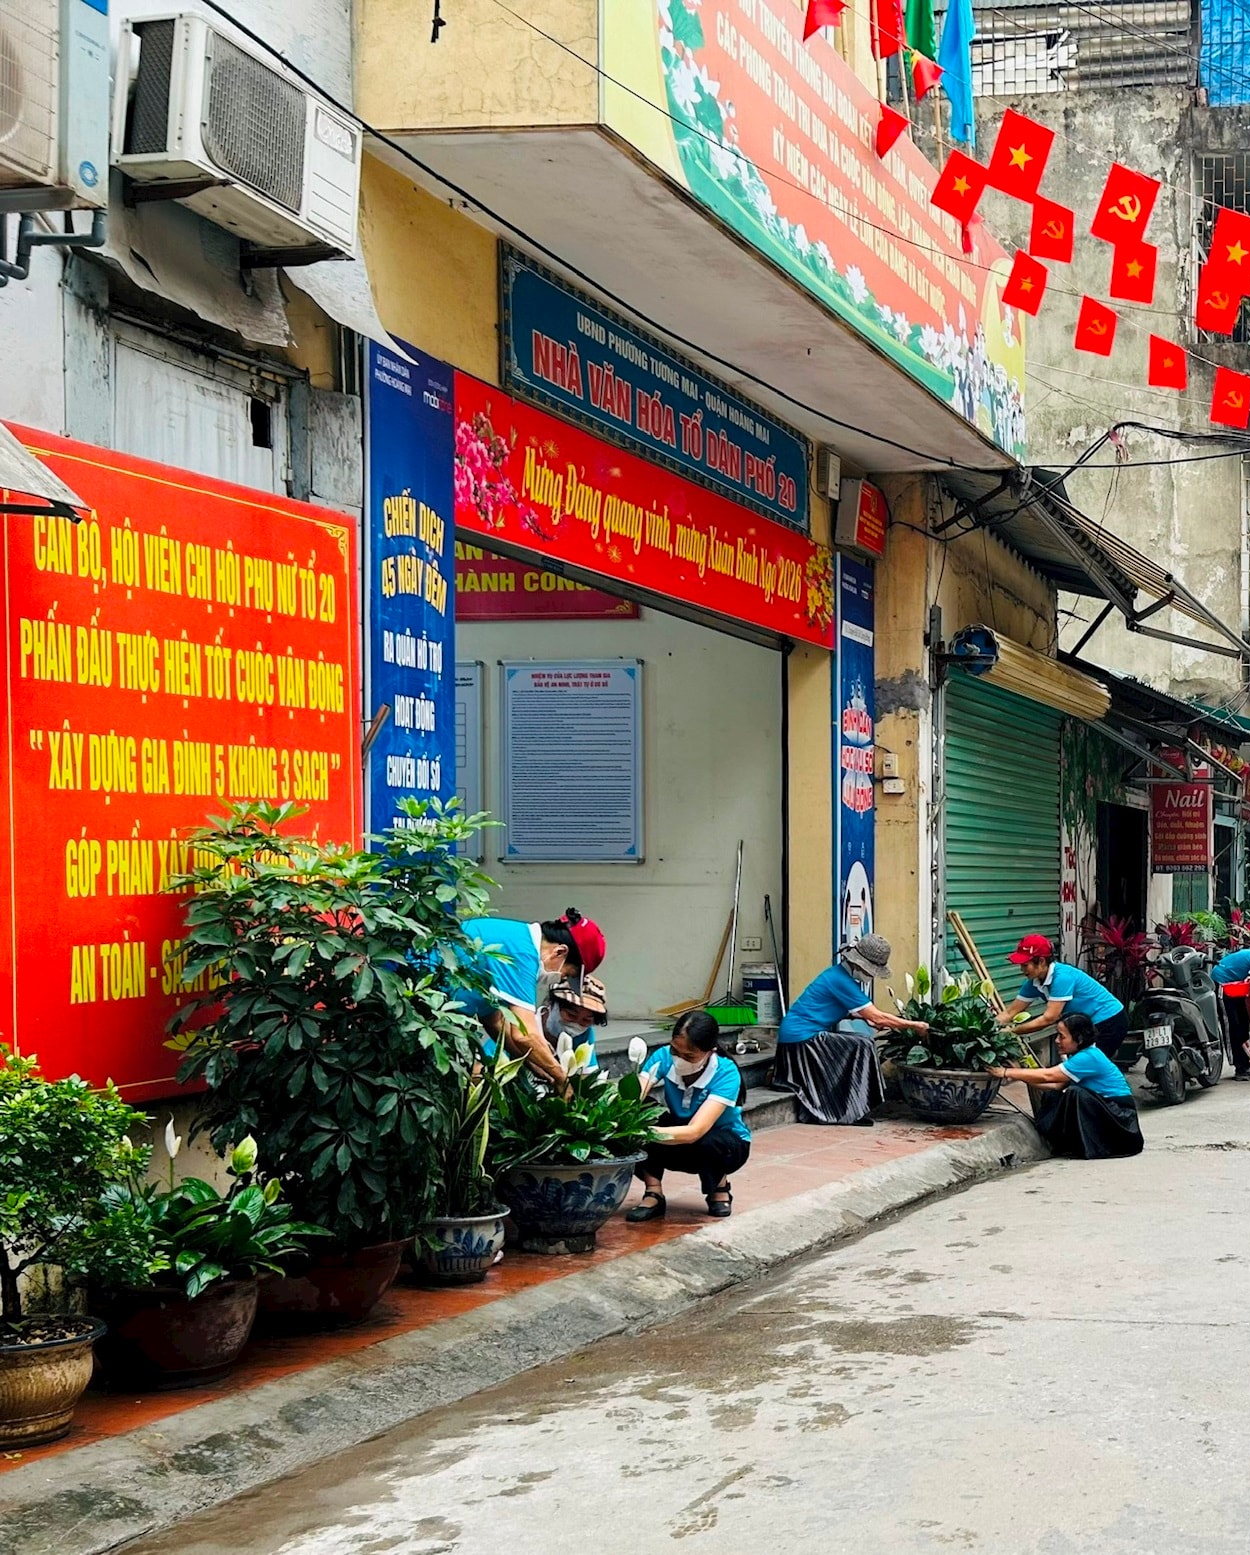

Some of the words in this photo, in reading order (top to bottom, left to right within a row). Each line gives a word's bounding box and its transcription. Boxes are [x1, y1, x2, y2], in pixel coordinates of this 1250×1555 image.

[717, 10, 738, 61] CÁC
[740, 33, 772, 98] PHONG
[773, 69, 796, 123] TRÀO
[797, 95, 811, 138] THI
[810, 163, 827, 205] CÁC
[577, 311, 606, 345] UBND
[608, 331, 648, 371] PHƯỜNG
[649, 355, 680, 389] TƯƠNG
[681, 375, 698, 400] MAI
[705, 391, 728, 419] QUẬN
[729, 405, 754, 436] HOÀNG
[755, 424, 770, 446] MAI
[532, 328, 584, 401] NHÀ
[587, 360, 632, 425] VĂN
[636, 388, 677, 449] HÓA
[679, 408, 704, 461] TỔ
[706, 428, 742, 484] DÂN
[745, 454, 777, 501] PHỐ
[778, 472, 797, 513] 20
[383, 487, 417, 539] CHIẾN
[419, 500, 445, 558] DỊCH
[521, 445, 564, 526] Mừng
[565, 463, 602, 540] Đảng
[602, 493, 644, 556] quang
[645, 499, 674, 560] vinh,
[675, 512, 707, 578] mừng
[708, 525, 735, 577] Xuân
[736, 537, 758, 586] Bính
[759, 547, 777, 605] Ngọ
[777, 555, 802, 604] 2026
[76, 508, 107, 595] BỘ,
[110, 516, 141, 600] HỘI
[143, 524, 182, 596] VIÊN
[185, 542, 213, 614] CHỊ
[215, 539, 241, 618] HỘI
[244, 555, 274, 624] PHỤ
[276, 551, 298, 617] NỮ
[299, 549, 317, 621] TỔ
[319, 572, 336, 624] 20
[382, 556, 396, 599] 45
[397, 546, 424, 598] NGÀY
[424, 558, 448, 618] ĐÊM
[19, 600, 73, 684] PHẤN
[76, 607, 113, 688] ĐẤU
[116, 629, 160, 704] THỰC
[163, 629, 202, 709] HIỆN
[204, 627, 232, 701] TỐT
[235, 640, 275, 717] CUỘC
[277, 645, 306, 720] VẬN
[308, 650, 344, 724] ĐỘNG
[383, 629, 395, 664] RA
[396, 627, 416, 668] QUÂN
[428, 640, 443, 681] TRỢ
[394, 694, 415, 735] HOẠT
[415, 691, 436, 738] ĐỘNG
[48, 718, 84, 791] XÂY
[88, 729, 138, 806] DỰNG
[141, 737, 170, 795] GIA
[172, 728, 212, 797] ĐÌNH
[215, 744, 225, 797] 5
[228, 734, 279, 799] KHÔNG
[281, 748, 290, 800] 3
[293, 748, 329, 808] SẠCH
[386, 748, 416, 789] CHUYỂN
[417, 751, 430, 790] ĐỔI
[430, 753, 442, 791] SỐ
[1165, 789, 1205, 808] Nail
[65, 825, 102, 899] GÓP
[106, 818, 154, 897] PHẦN
[70, 944, 96, 1005] AN
[100, 929, 146, 1002] TOÀN
